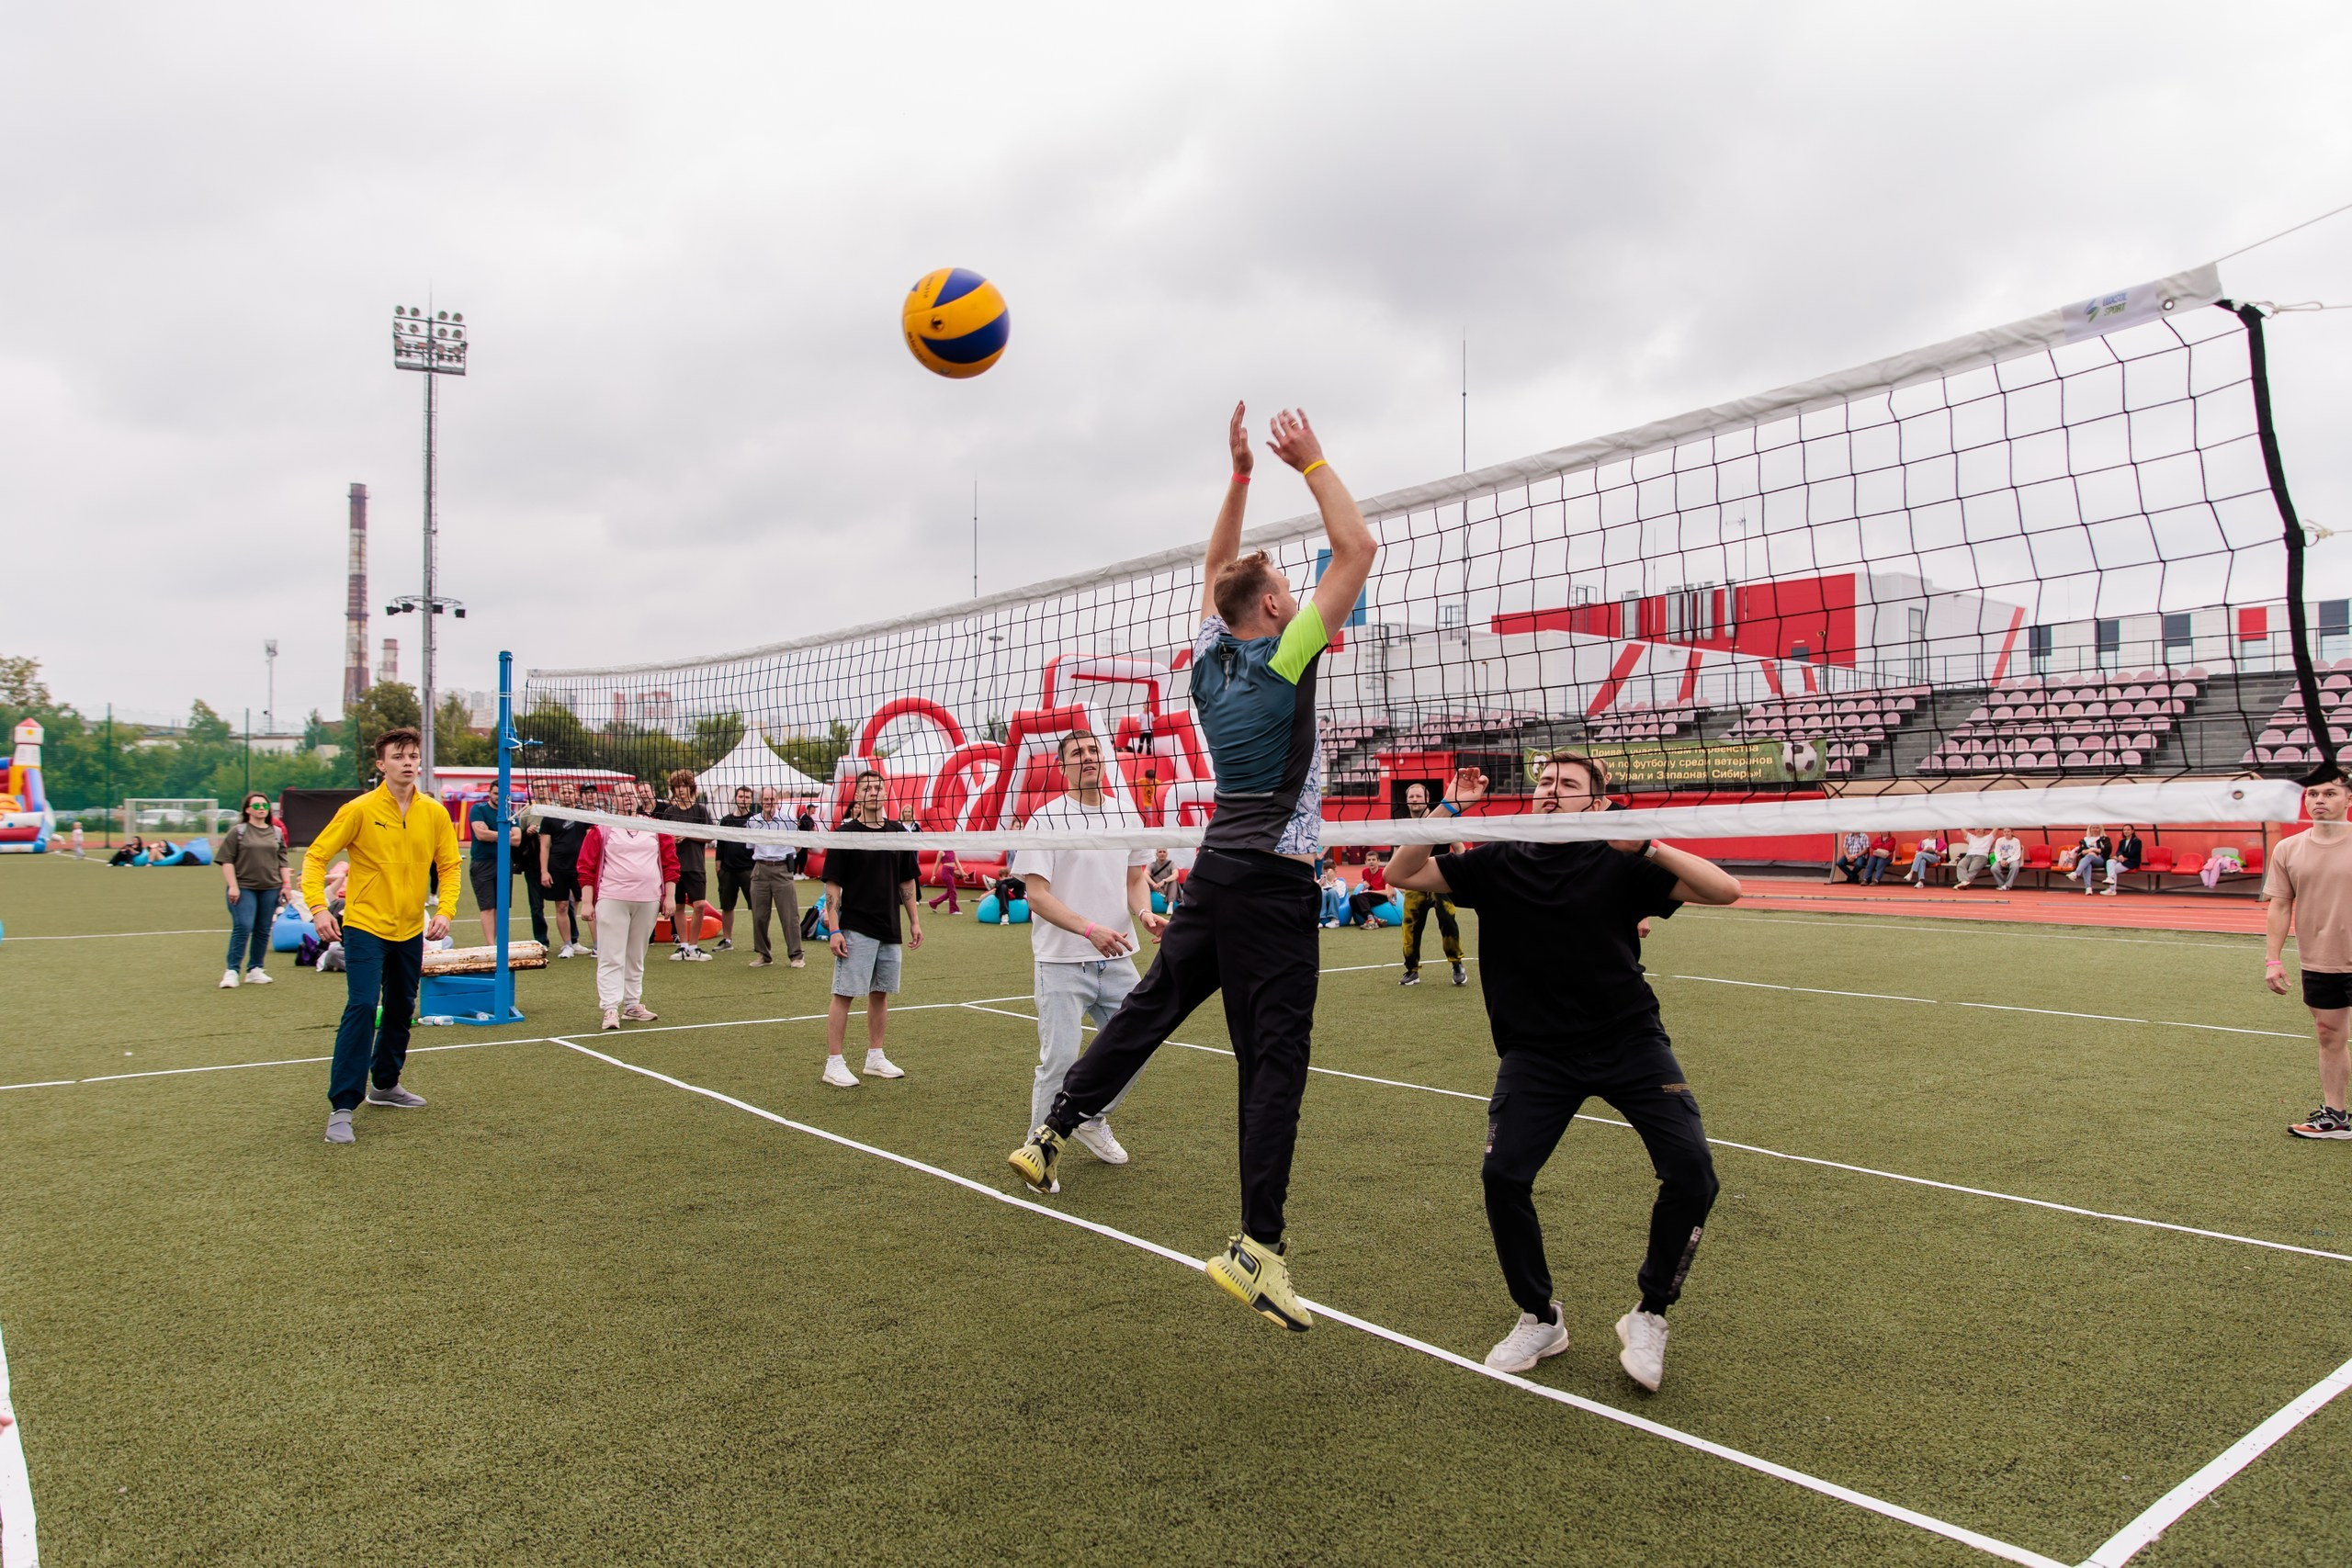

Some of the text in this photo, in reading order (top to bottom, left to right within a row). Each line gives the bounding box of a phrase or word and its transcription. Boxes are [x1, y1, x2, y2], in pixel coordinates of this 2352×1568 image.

[2104, 302, 2127, 316] SPORT
[1590, 749, 1625, 757] Привет
[1630, 747, 1691, 757] участникам
[1618, 761, 1630, 769] по
[1634, 759, 1676, 770] футболу
[1679, 759, 1711, 768] среди
[1714, 757, 1773, 767] ветеранов
[1657, 771, 1708, 780] Западная
